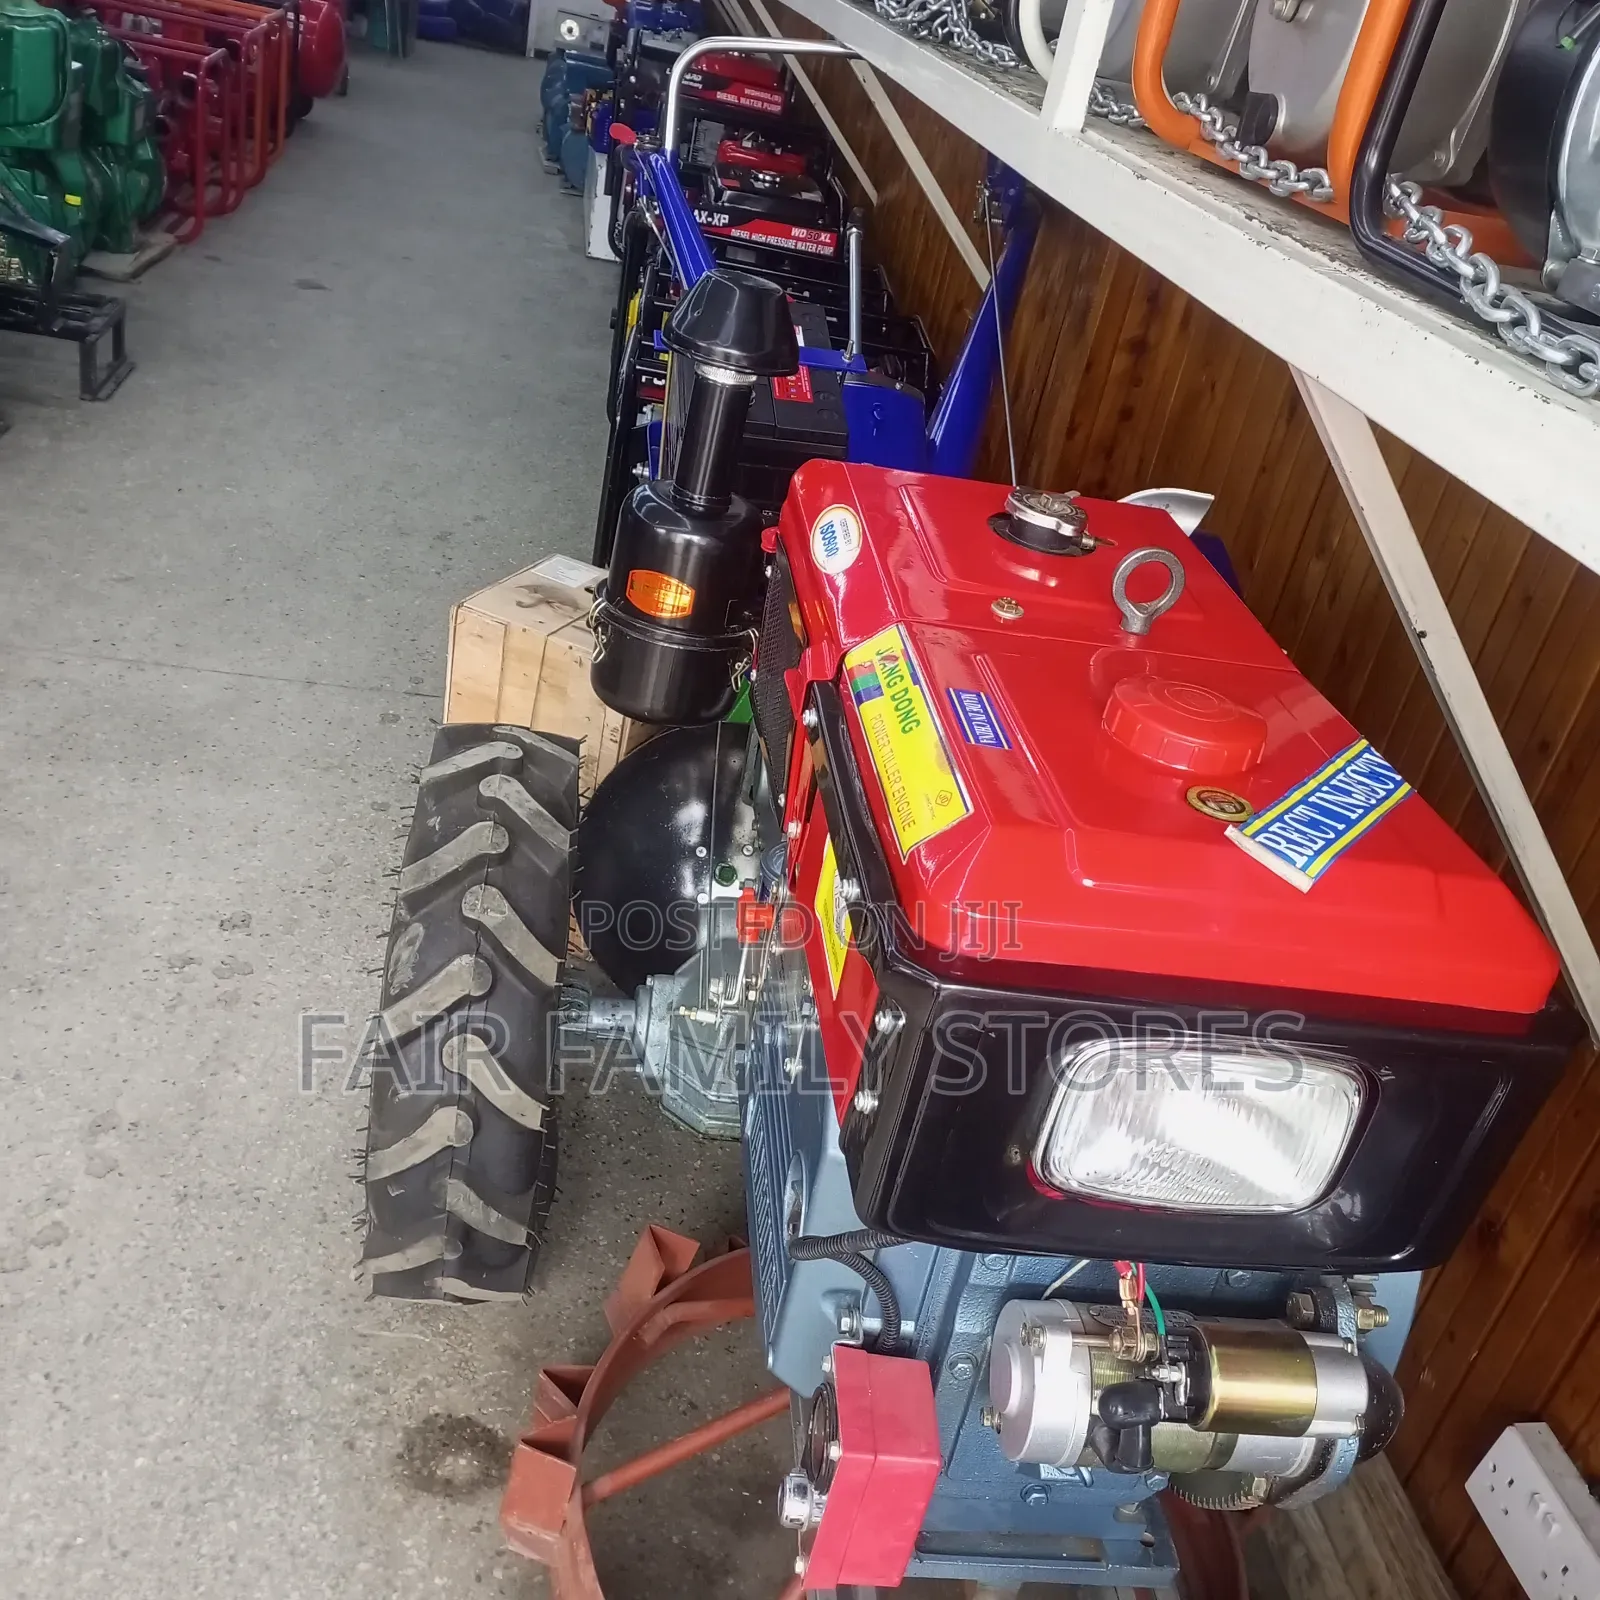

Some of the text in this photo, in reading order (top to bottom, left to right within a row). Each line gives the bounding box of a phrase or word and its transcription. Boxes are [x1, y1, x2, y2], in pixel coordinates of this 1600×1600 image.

[716, 91, 781, 112] DIESEL WATER PUMP
[730, 228, 834, 257] DIESEL HIGH PRESSURE WATER PUMP
[889, 687, 921, 734] DONG
[959, 692, 998, 744] MADE IN CHINA
[870, 713, 916, 832] POWER TILLER ENGINE
[1254, 804, 1347, 869] RECT
